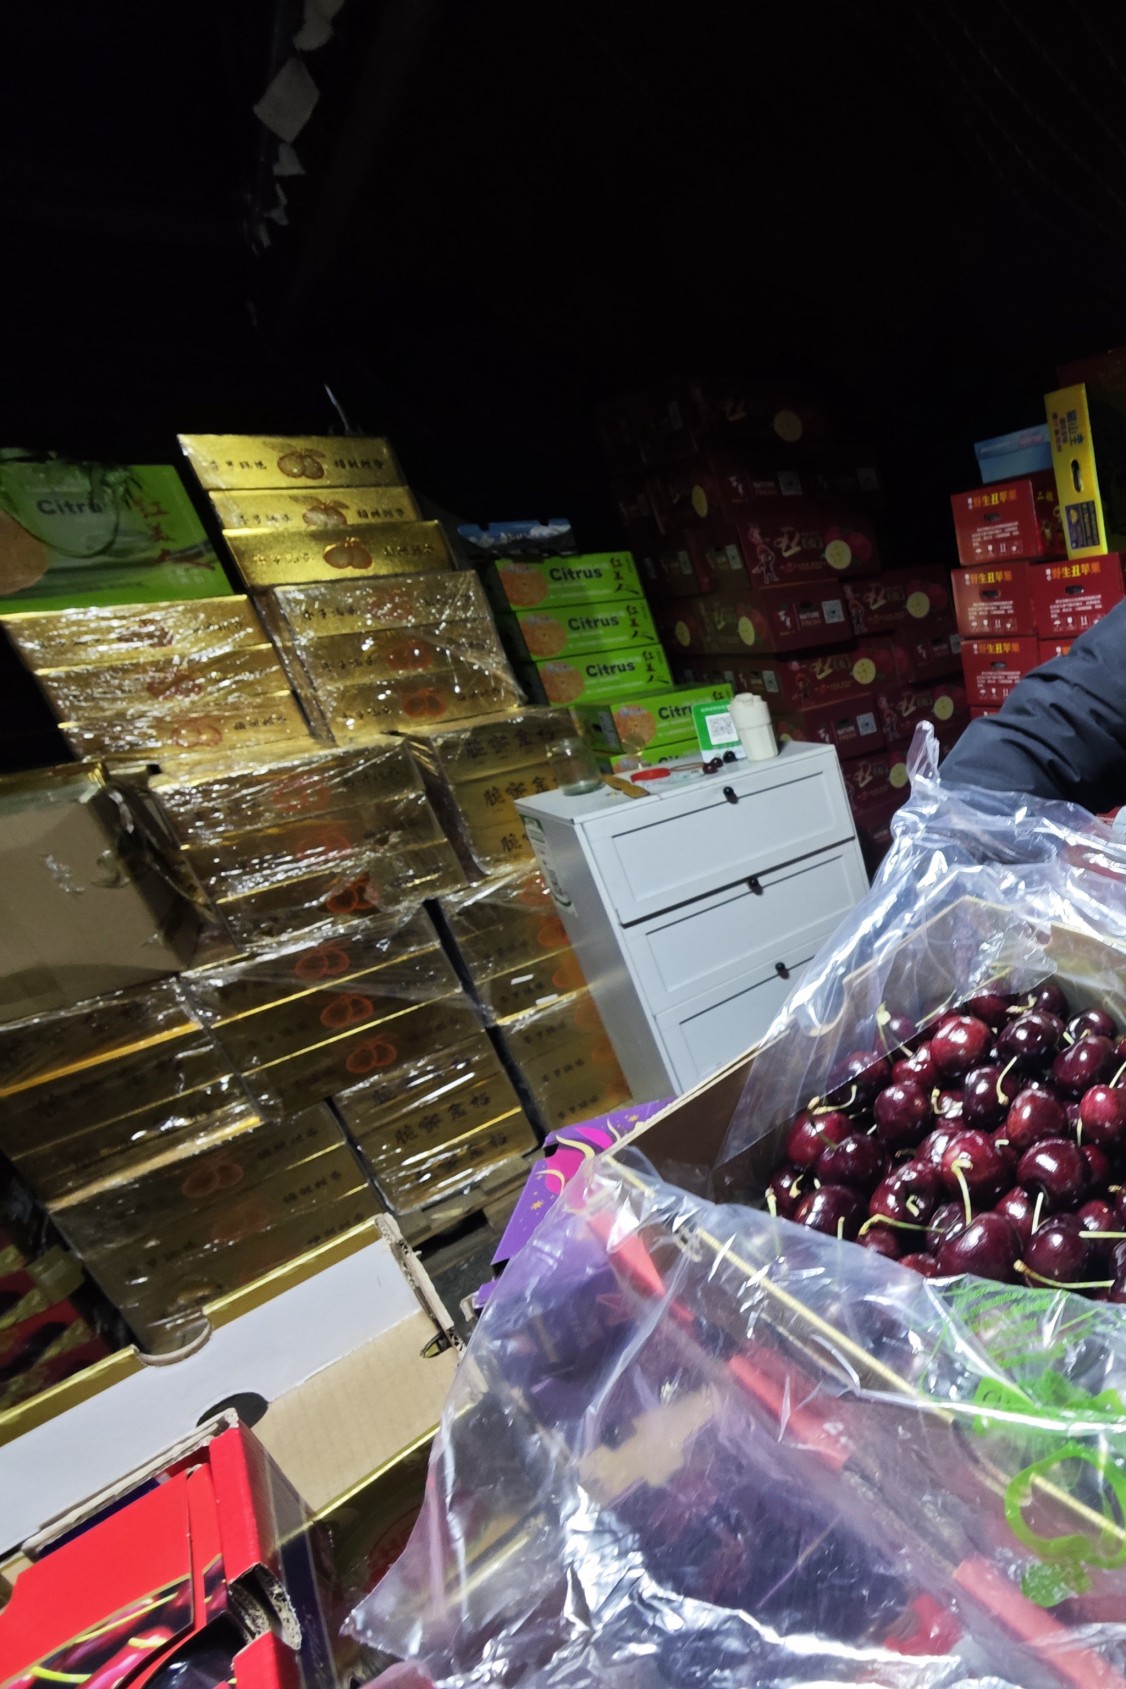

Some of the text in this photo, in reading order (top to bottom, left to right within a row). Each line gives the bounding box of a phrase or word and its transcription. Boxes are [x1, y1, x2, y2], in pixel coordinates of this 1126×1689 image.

[549, 565, 603, 582] Citrus
[610, 557, 640, 595] 红美人
[567, 615, 620, 632] Citrus
[626, 604, 655, 641] 红美人
[585, 660, 636, 678] Citrus
[642, 650, 670, 685] 红美人
